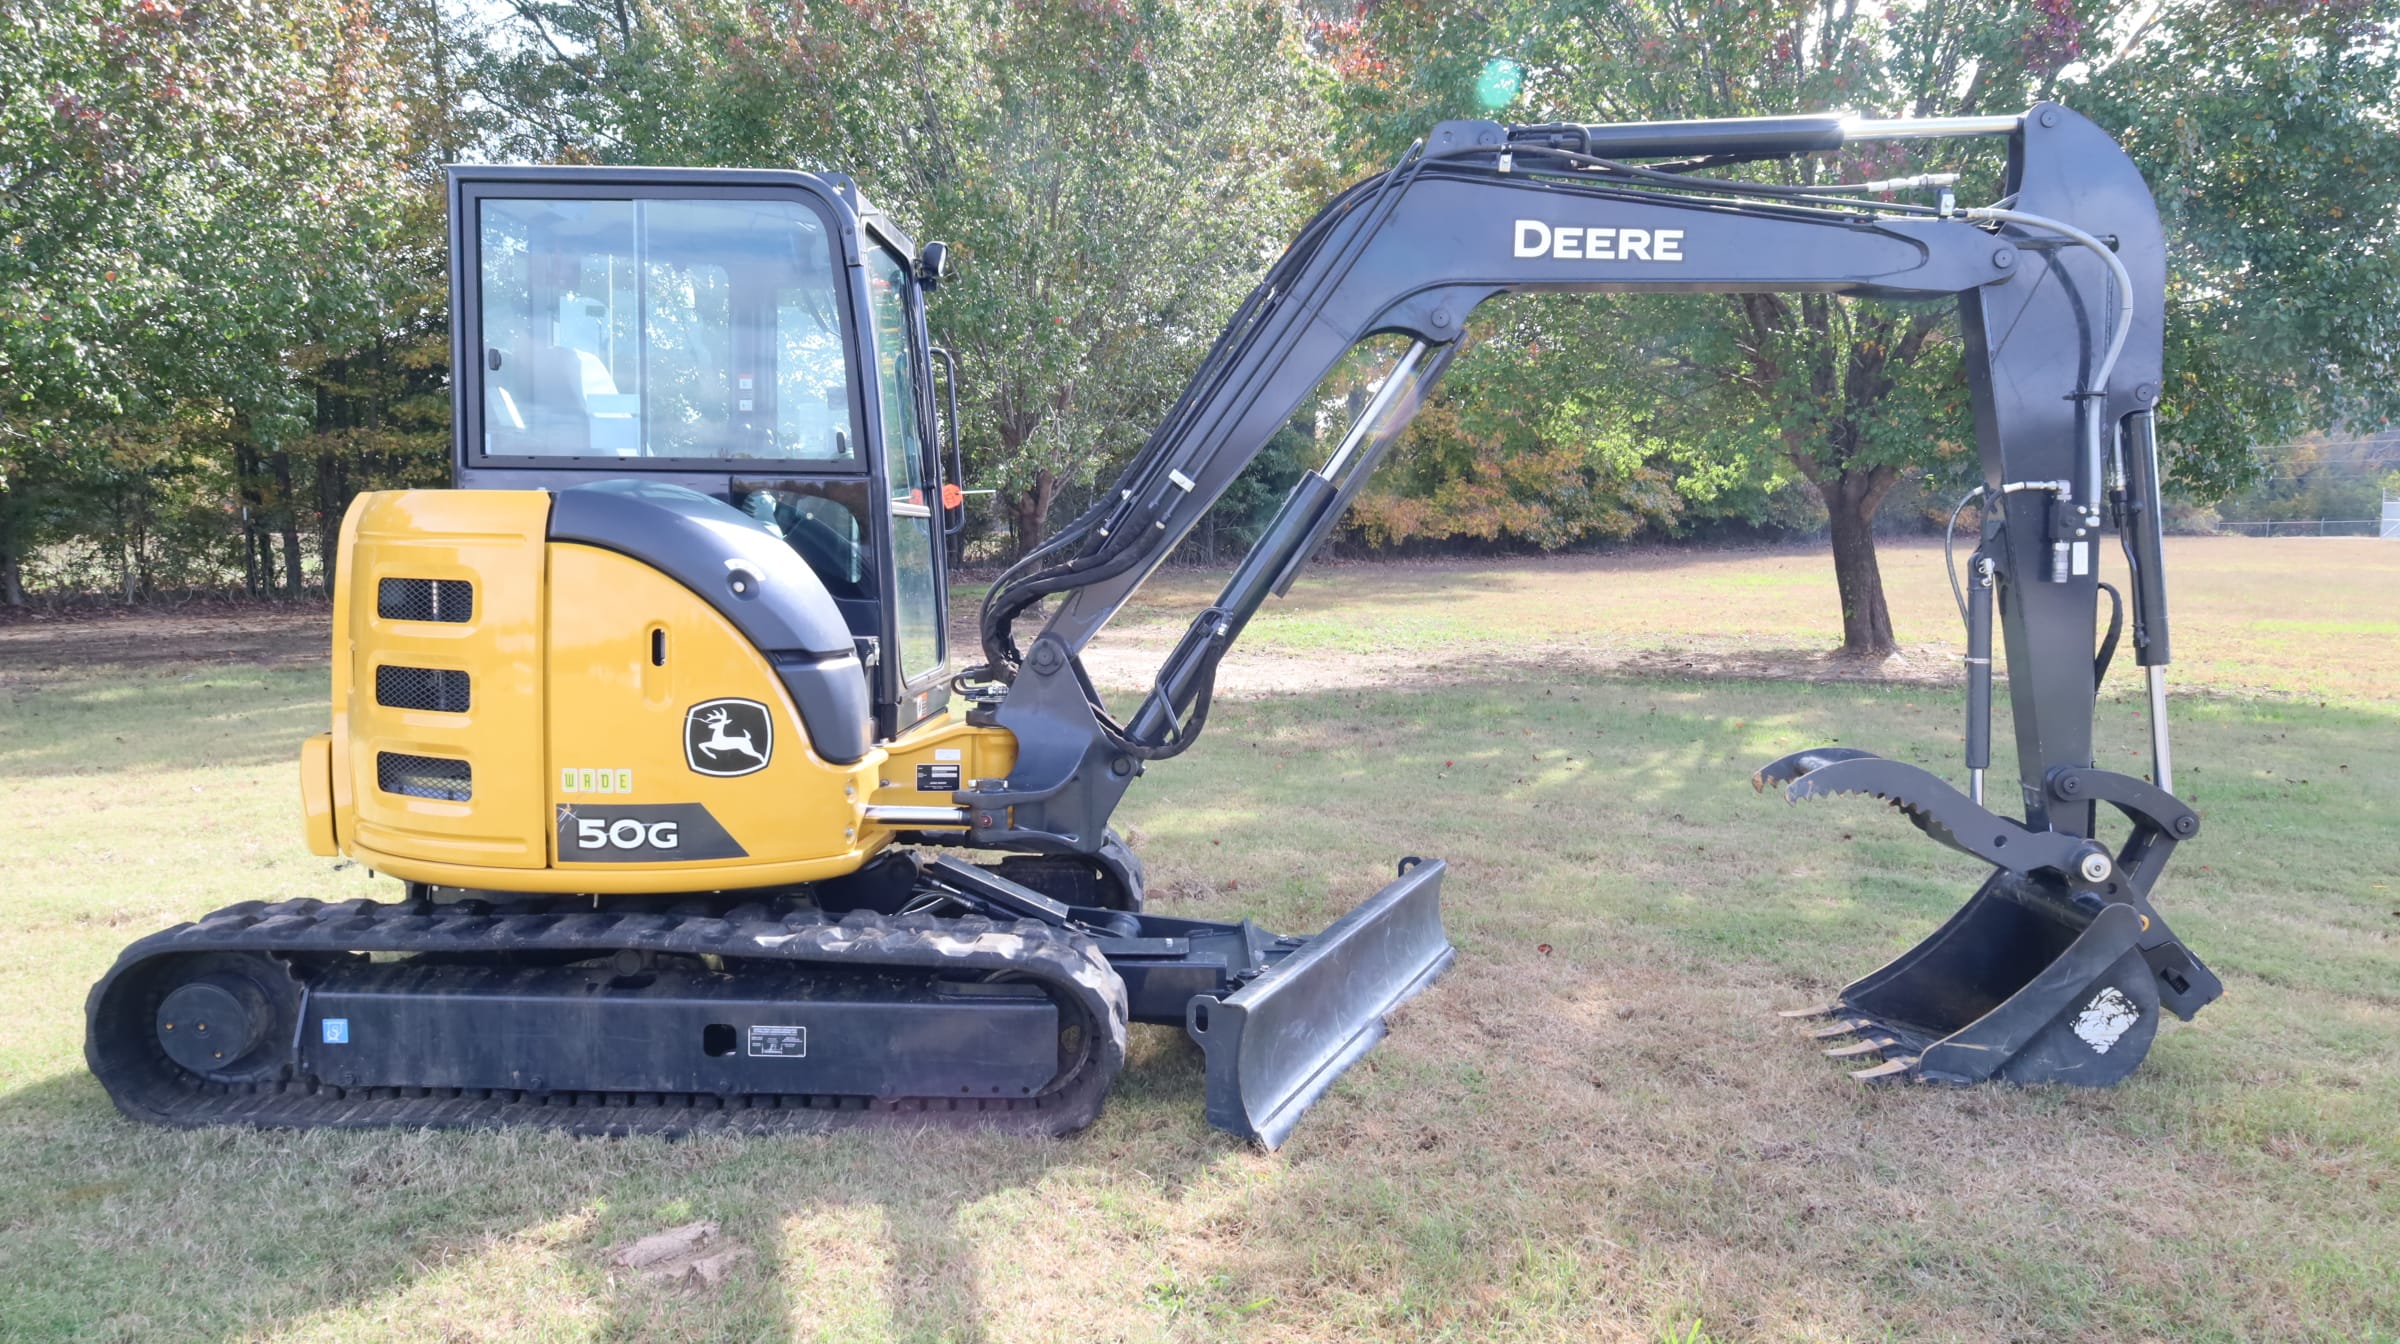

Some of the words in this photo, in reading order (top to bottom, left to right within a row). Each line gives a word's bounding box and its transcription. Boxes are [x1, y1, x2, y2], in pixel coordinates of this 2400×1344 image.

[1513, 219, 1685, 261] DEERE
[563, 772, 629, 790] WADE
[578, 818, 678, 849] 50G
